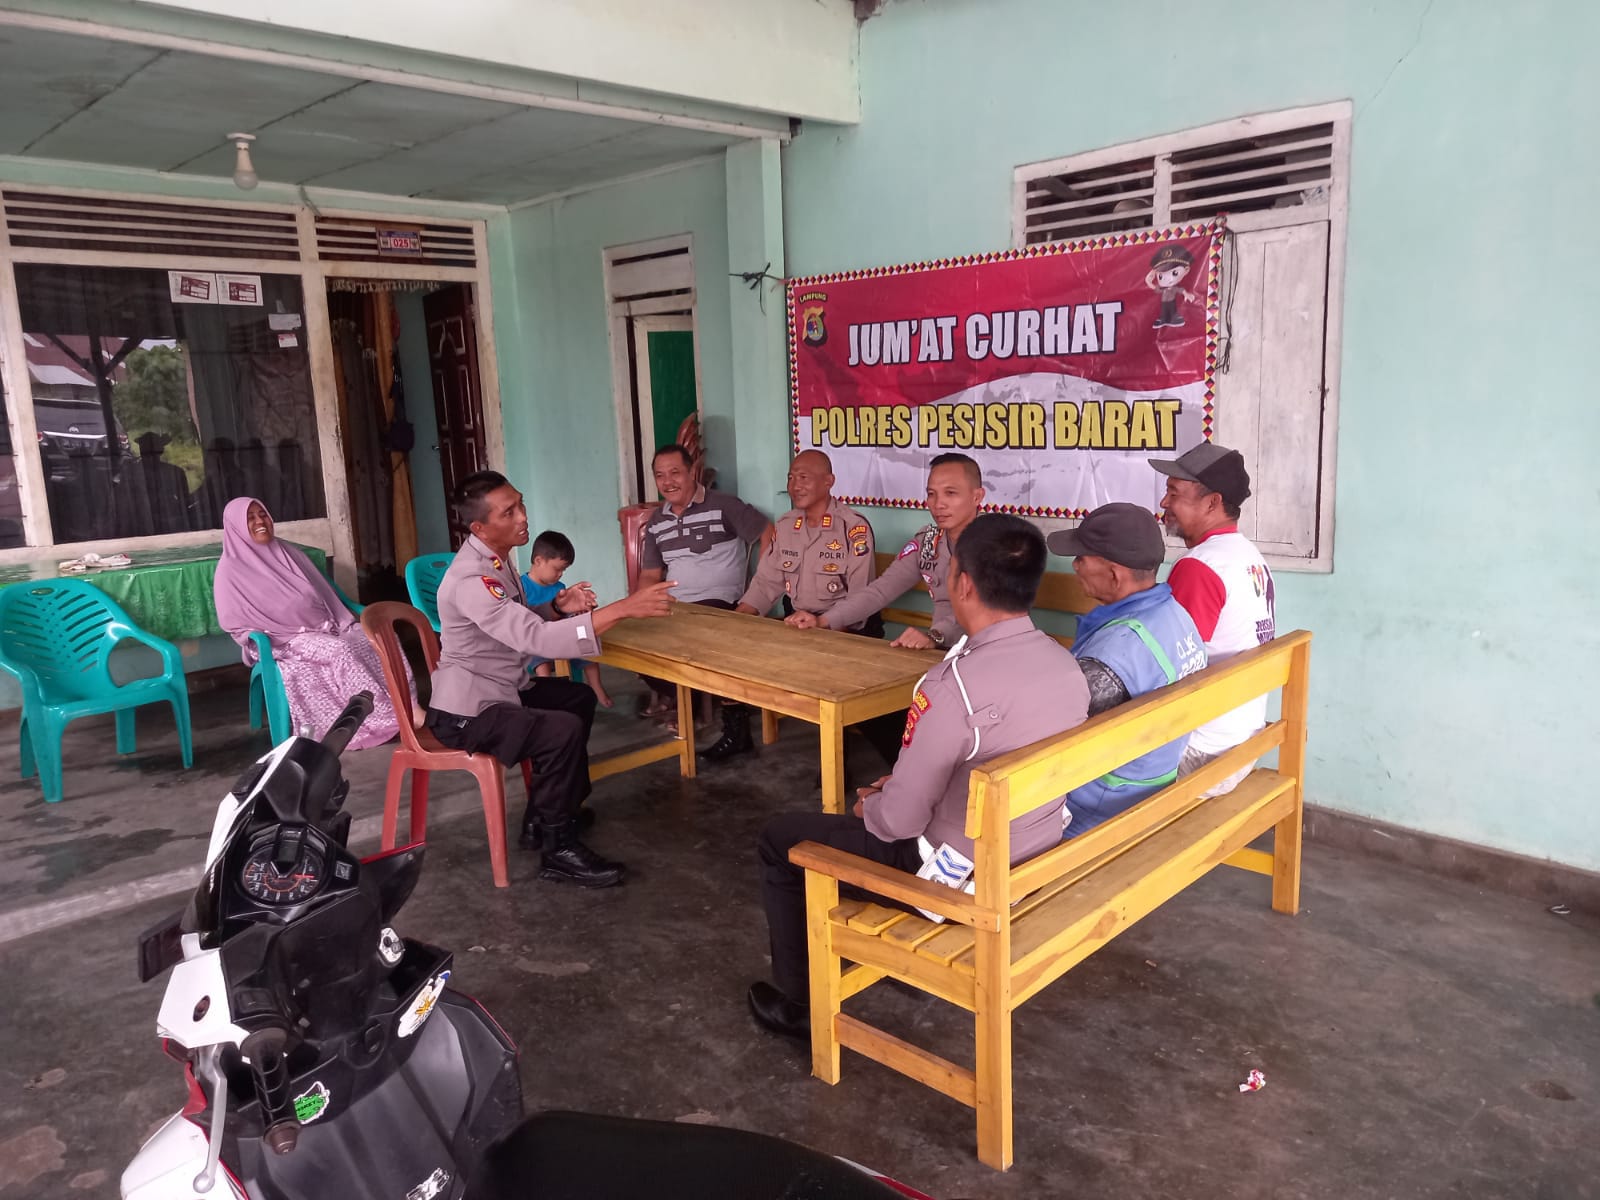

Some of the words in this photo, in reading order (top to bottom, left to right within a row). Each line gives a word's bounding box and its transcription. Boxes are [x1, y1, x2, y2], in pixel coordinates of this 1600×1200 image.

[393, 239, 409, 248] 025
[799, 292, 827, 304] LAMPUNG
[848, 315, 957, 366] JUM'AT
[964, 301, 1122, 359] CURHAT
[811, 406, 911, 447] POLRES
[918, 402, 1046, 448] PESISIR
[1054, 400, 1181, 450] BARAT
[819, 551, 845, 560] POLRI
